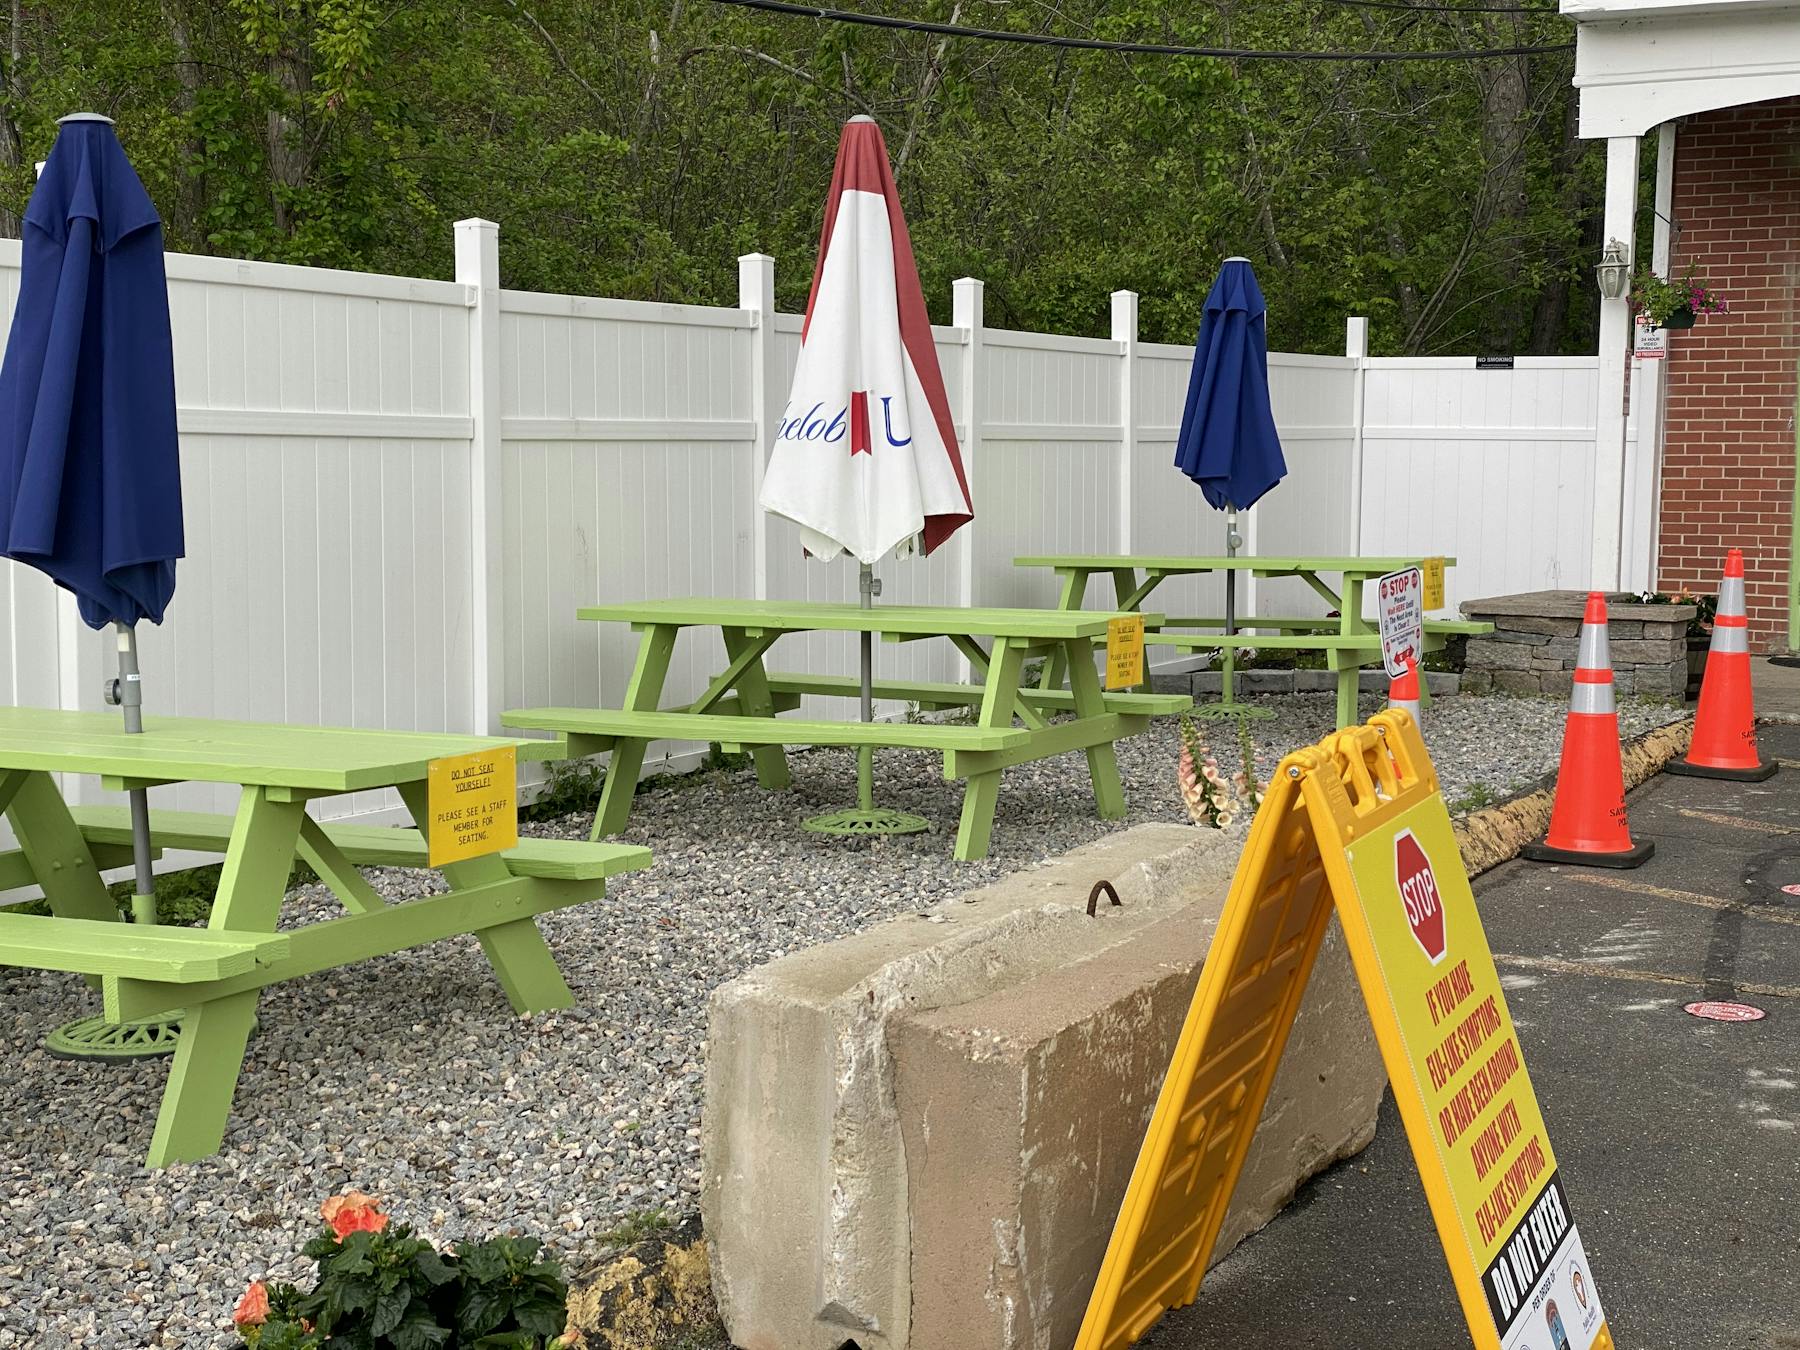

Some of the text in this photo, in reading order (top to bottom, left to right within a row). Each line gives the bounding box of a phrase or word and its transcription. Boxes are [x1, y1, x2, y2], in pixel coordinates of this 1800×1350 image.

[1390, 575, 1409, 596] STOP
[451, 763, 495, 780] DO NOT SEAT
[455, 778, 491, 793] YOURSELF!
[437, 800, 507, 824] PLEASE SEE A STAFF
[453, 817, 493, 832] MEMBER FOR
[458, 831, 489, 845] SEATING.
[1402, 868, 1436, 927] STOP
[1425, 959, 1475, 1027] IF YOU HAVE
[1425, 994, 1501, 1093] FLU-LIKE SYMPTOMS
[1439, 1038, 1519, 1148] OR HAVE BEEN AROUND
[1470, 1098, 1522, 1183] ANYONE WITH
[1475, 1134, 1546, 1248] FLU-LIKE SYMPTOMS
[1490, 1183, 1568, 1322] DO NOT ENTER
